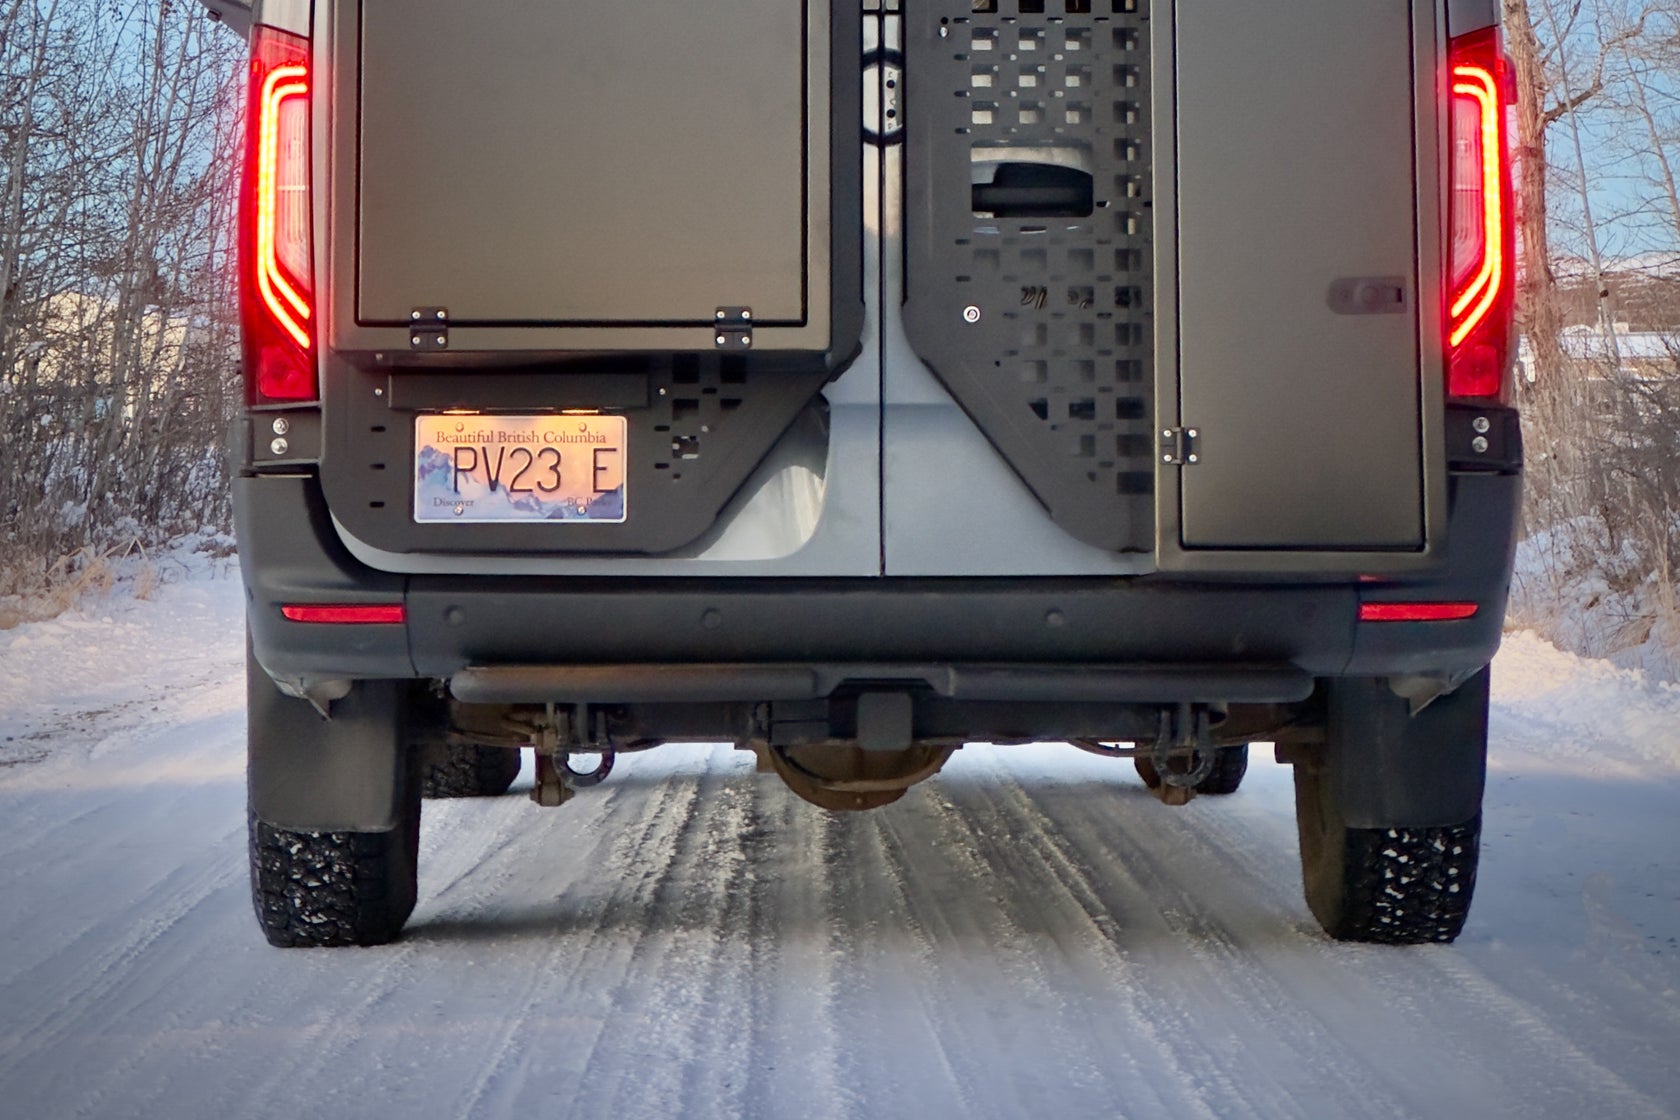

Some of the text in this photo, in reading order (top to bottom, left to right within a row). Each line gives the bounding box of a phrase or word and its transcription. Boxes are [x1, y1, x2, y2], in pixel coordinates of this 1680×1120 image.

[436, 430, 606, 443] Beautiful British Columbia
[433, 496, 474, 507] Discover
